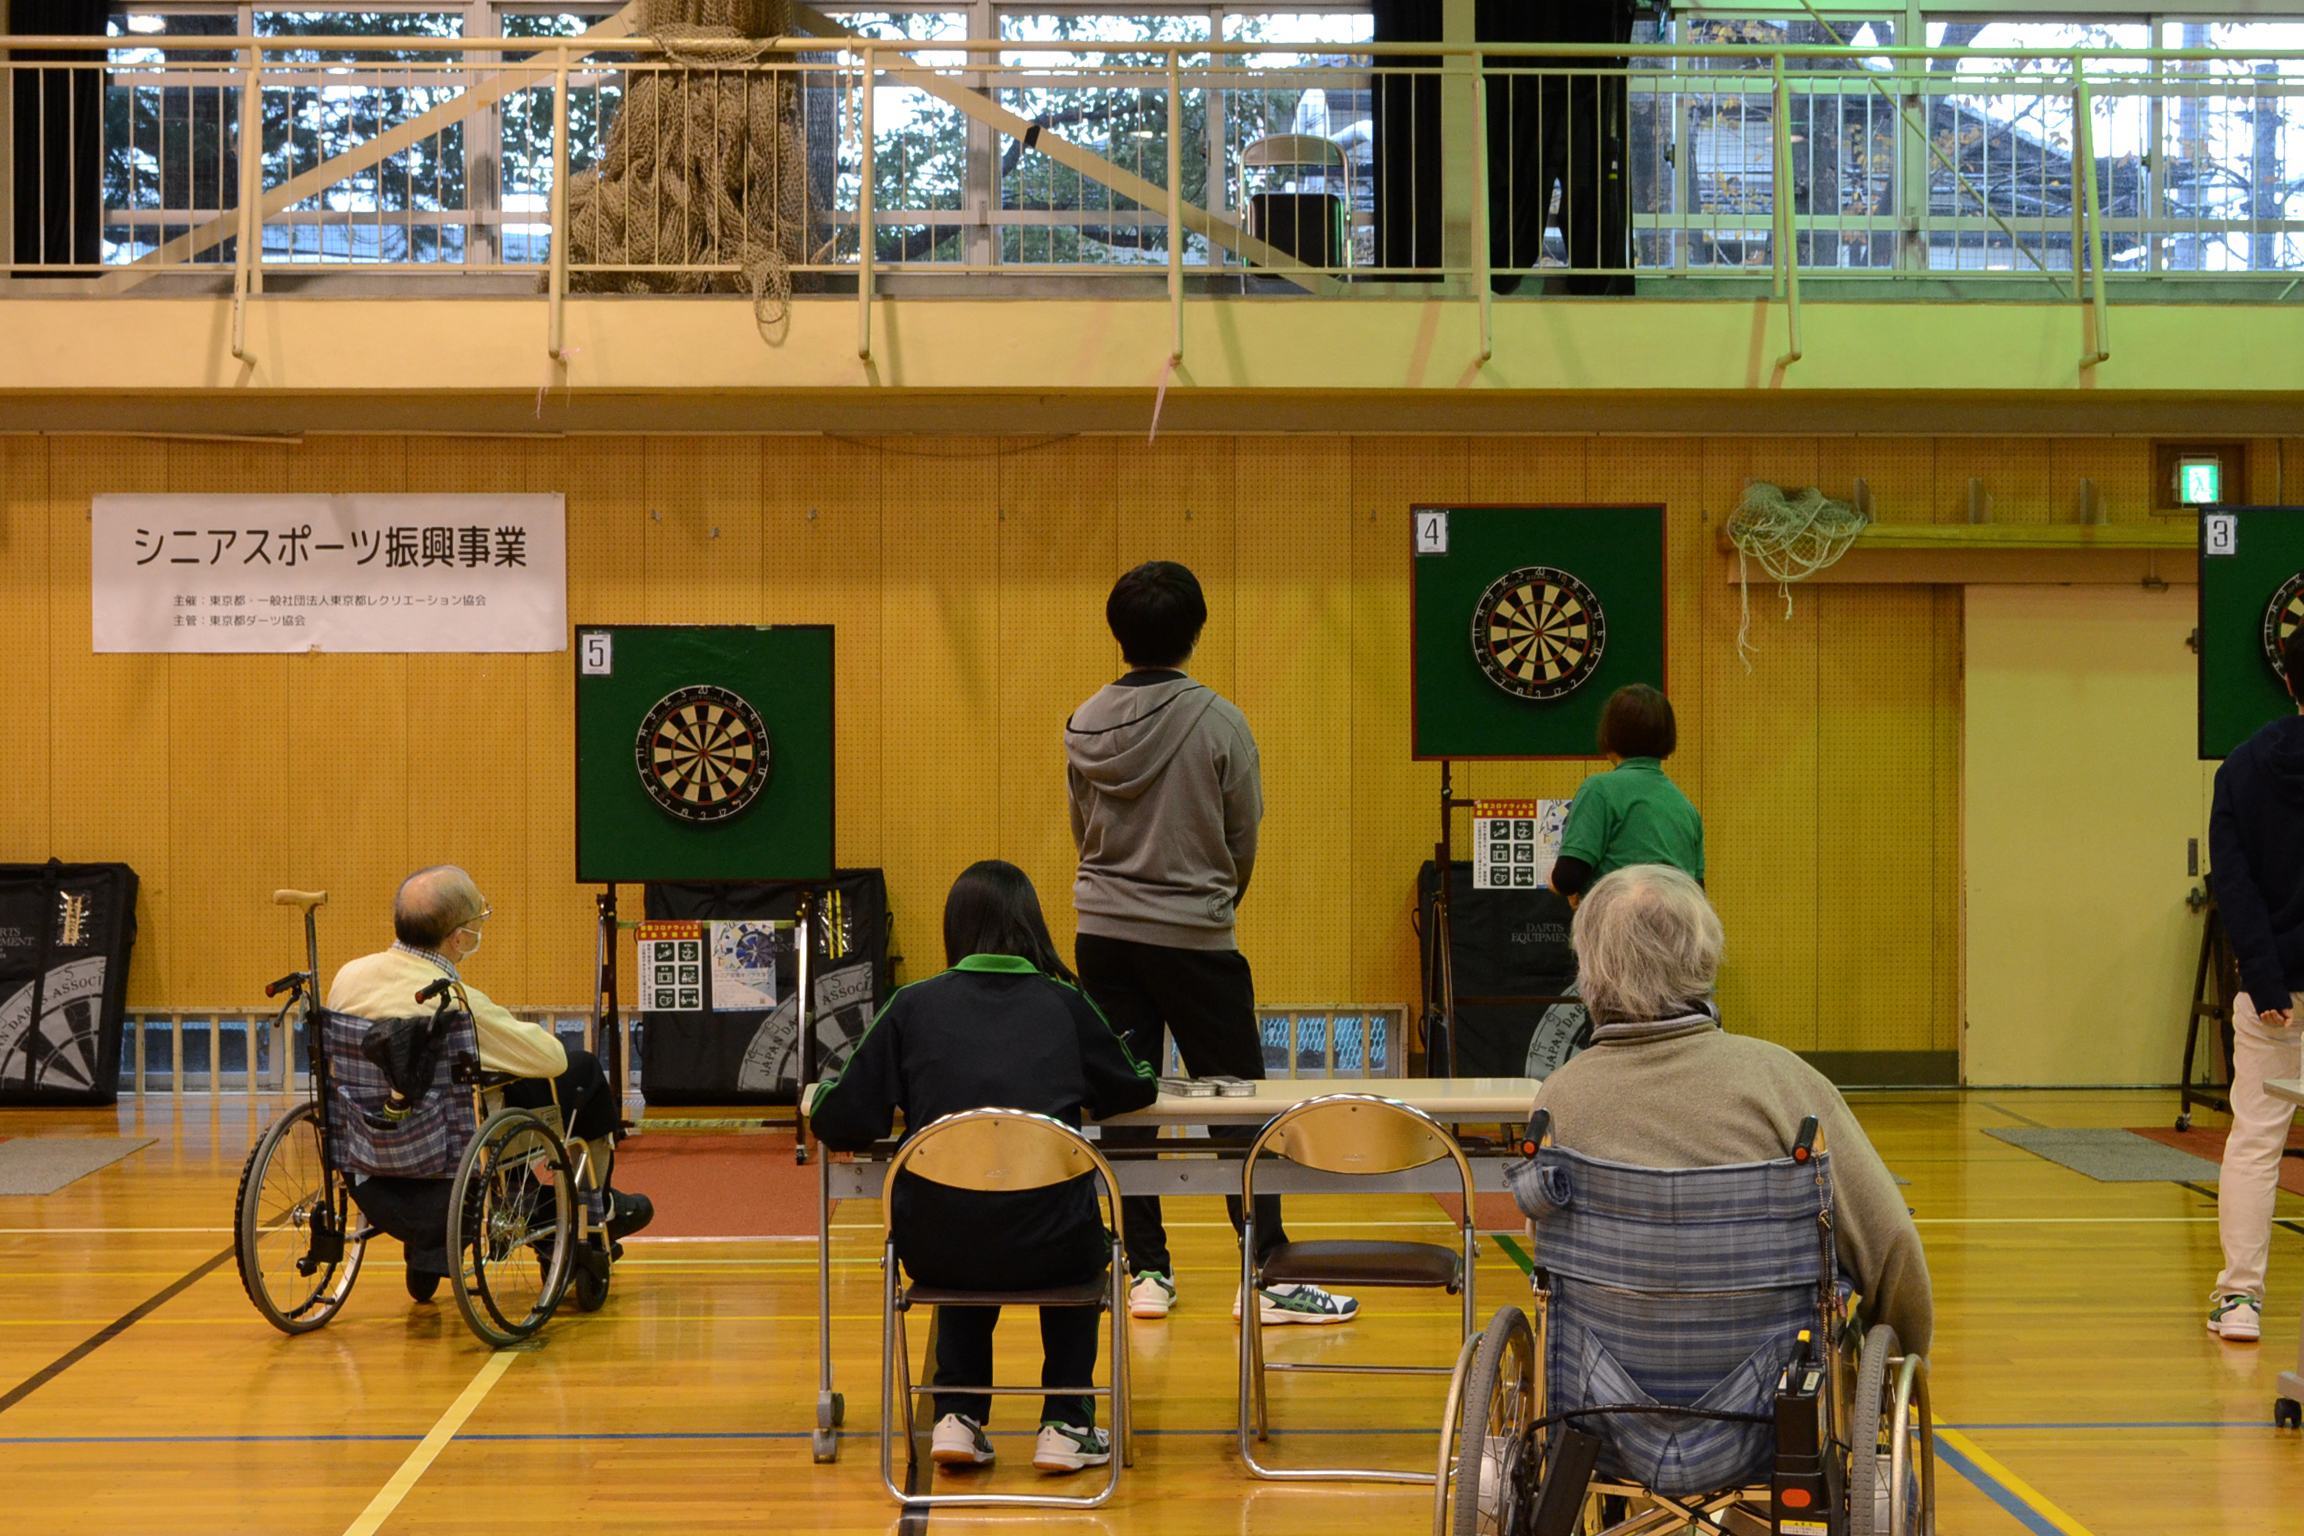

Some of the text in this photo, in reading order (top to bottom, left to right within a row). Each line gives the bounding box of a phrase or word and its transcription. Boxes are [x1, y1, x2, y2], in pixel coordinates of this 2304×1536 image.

[1424, 518, 1439, 545] 4
[2213, 520, 2228, 547] 3
[134, 524, 527, 568] シニアスポーツ振興事業
[173, 614, 306, 627] 主管：東京都ダーツ協会
[589, 639, 604, 667] 5
[724, 700, 746, 717] BOARD
[1511, 933, 1570, 944] EQUIPMEN
[1527, 923, 1564, 932] DARTS
[8, 994, 48, 1029] DARS
[760, 981, 872, 1076] JAPAN ASSOCI
[1545, 1003, 1588, 1071] JAPAN DAR
